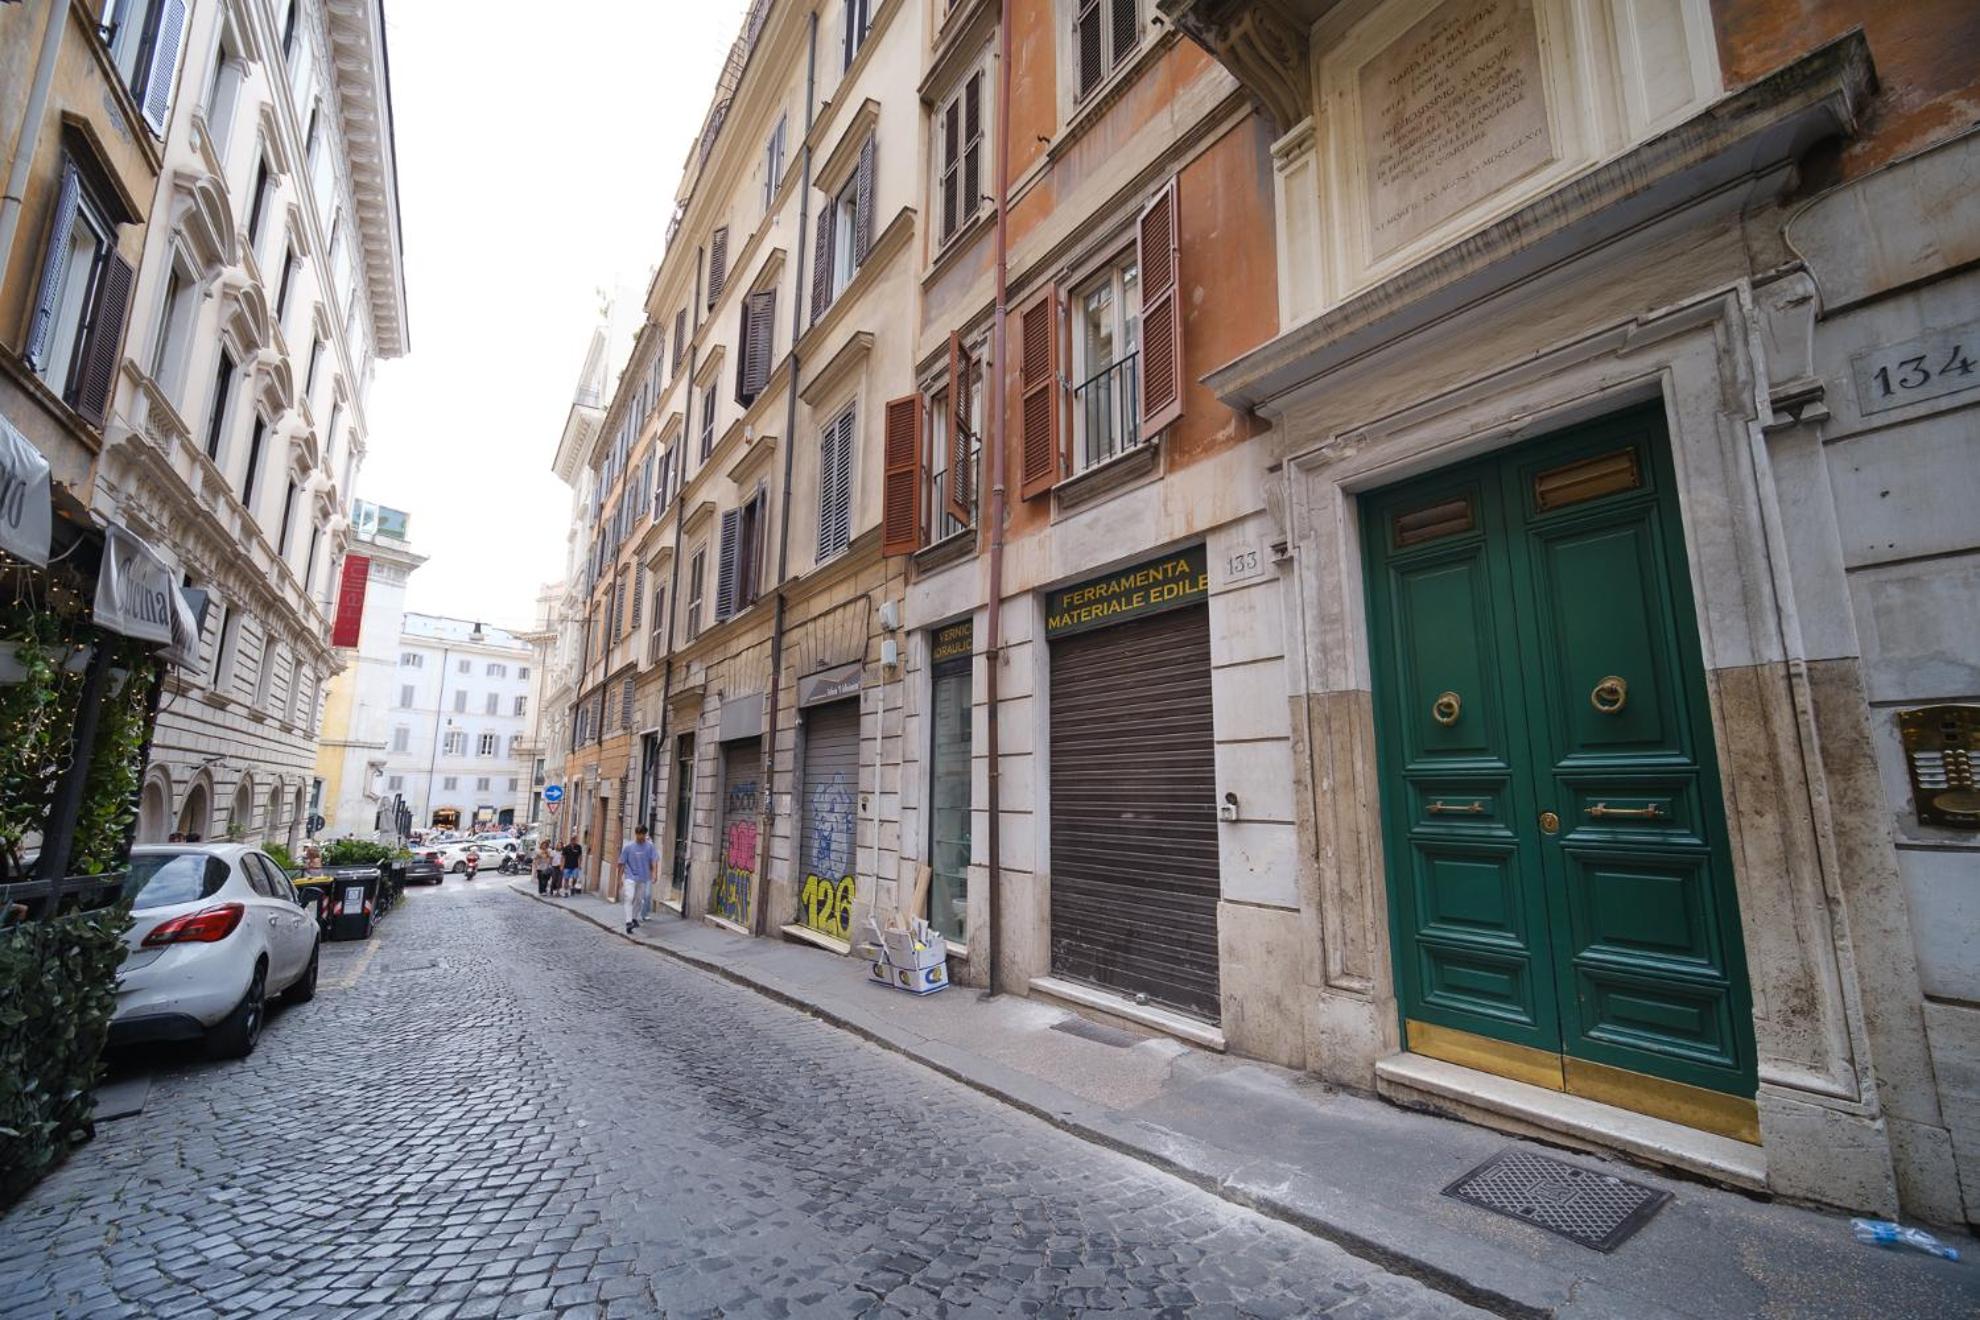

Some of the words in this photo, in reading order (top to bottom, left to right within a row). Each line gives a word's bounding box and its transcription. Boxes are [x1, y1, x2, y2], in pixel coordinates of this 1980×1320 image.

[1873, 345, 1979, 398] 134
[1063, 559, 1190, 608] FERRAMENTA
[1226, 551, 1258, 576] 133
[1047, 591, 1146, 630] MATERIALE
[1149, 573, 1208, 604] EDILE
[801, 873, 857, 943] 126
